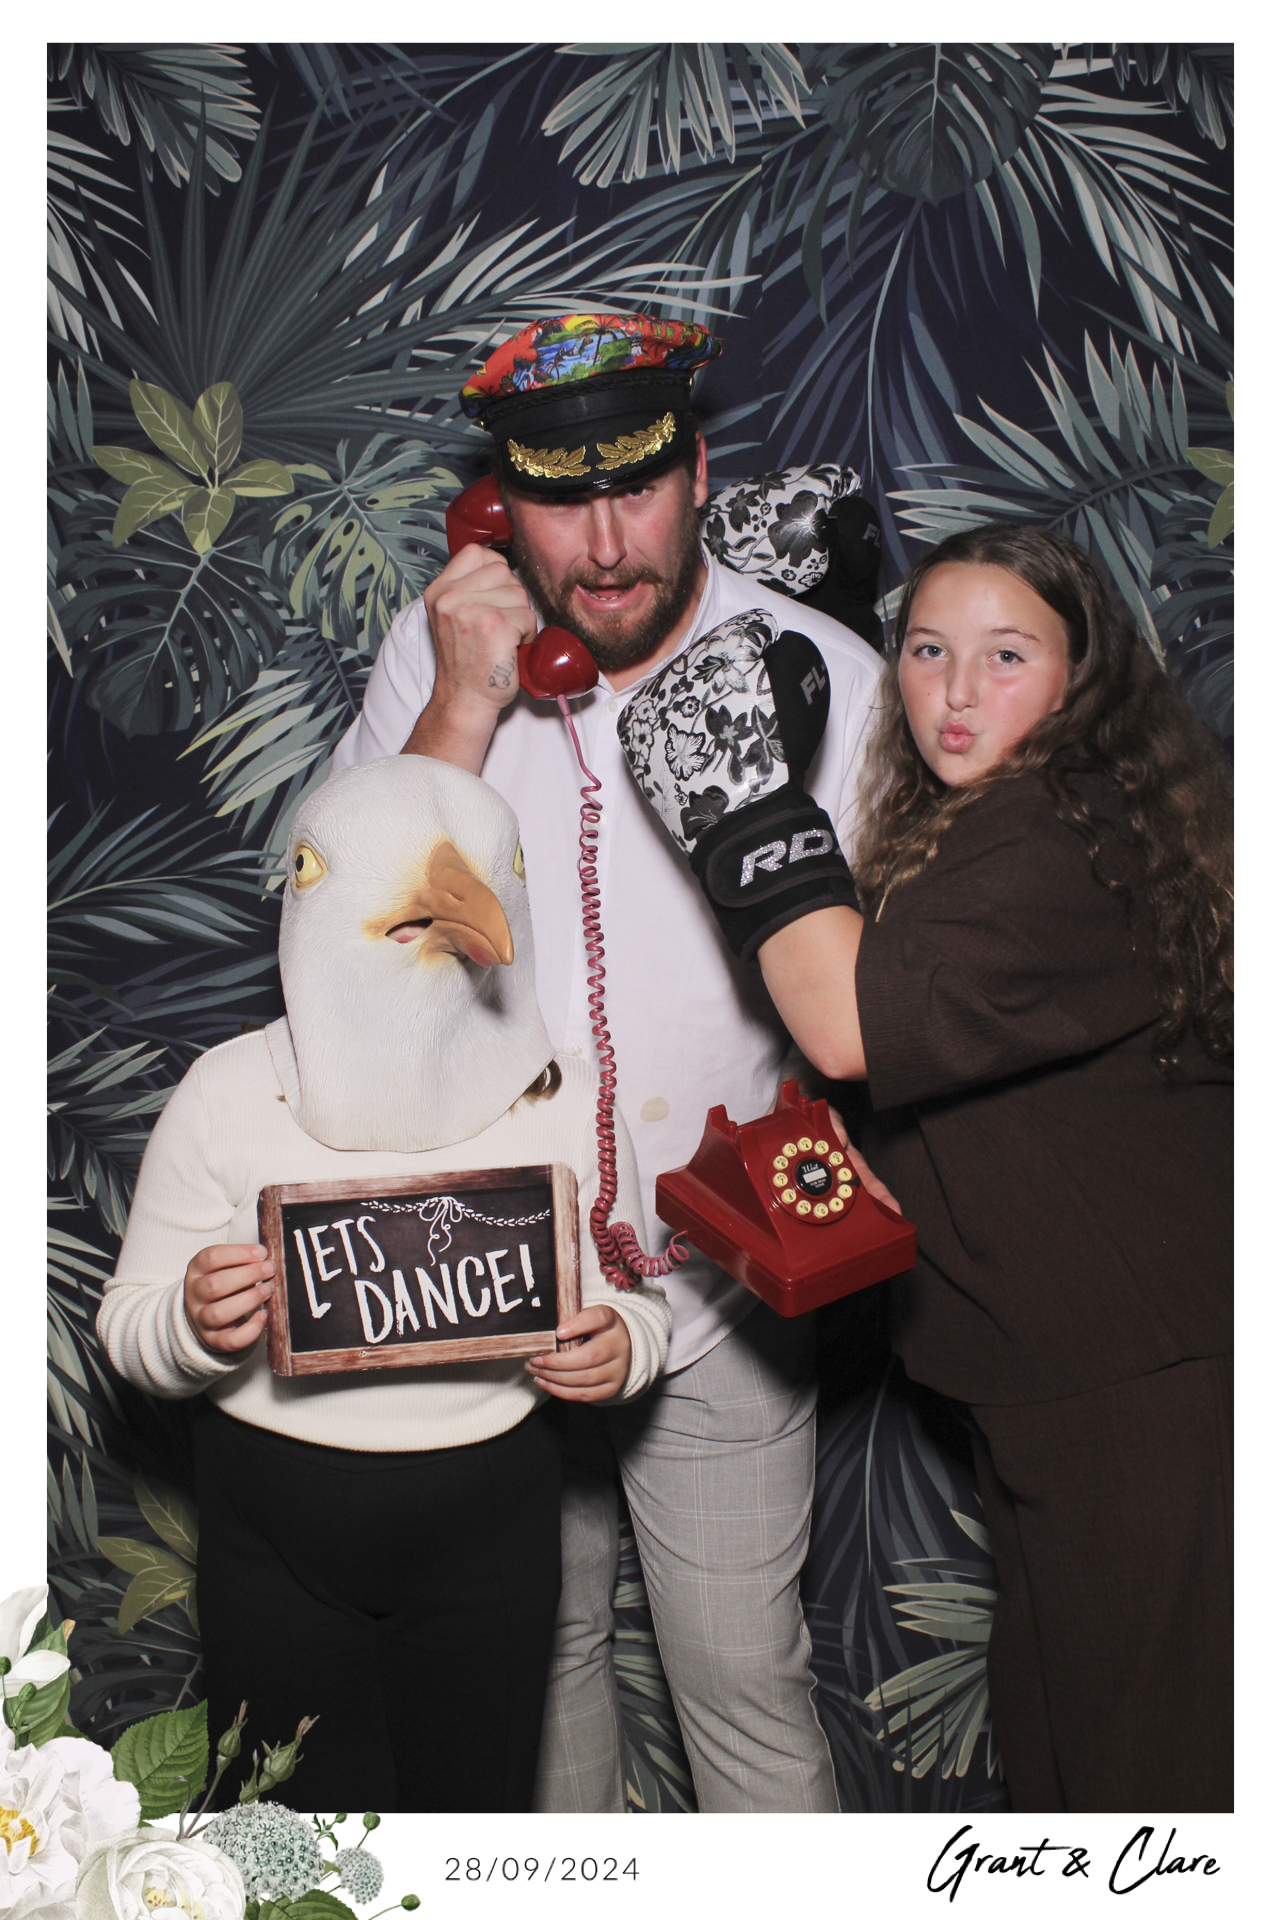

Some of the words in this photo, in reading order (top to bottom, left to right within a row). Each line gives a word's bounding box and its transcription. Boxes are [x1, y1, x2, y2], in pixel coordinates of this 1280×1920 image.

[740, 828, 843, 888] RD
[293, 1215, 386, 1319] LETS
[354, 1244, 541, 1344] DANCE!
